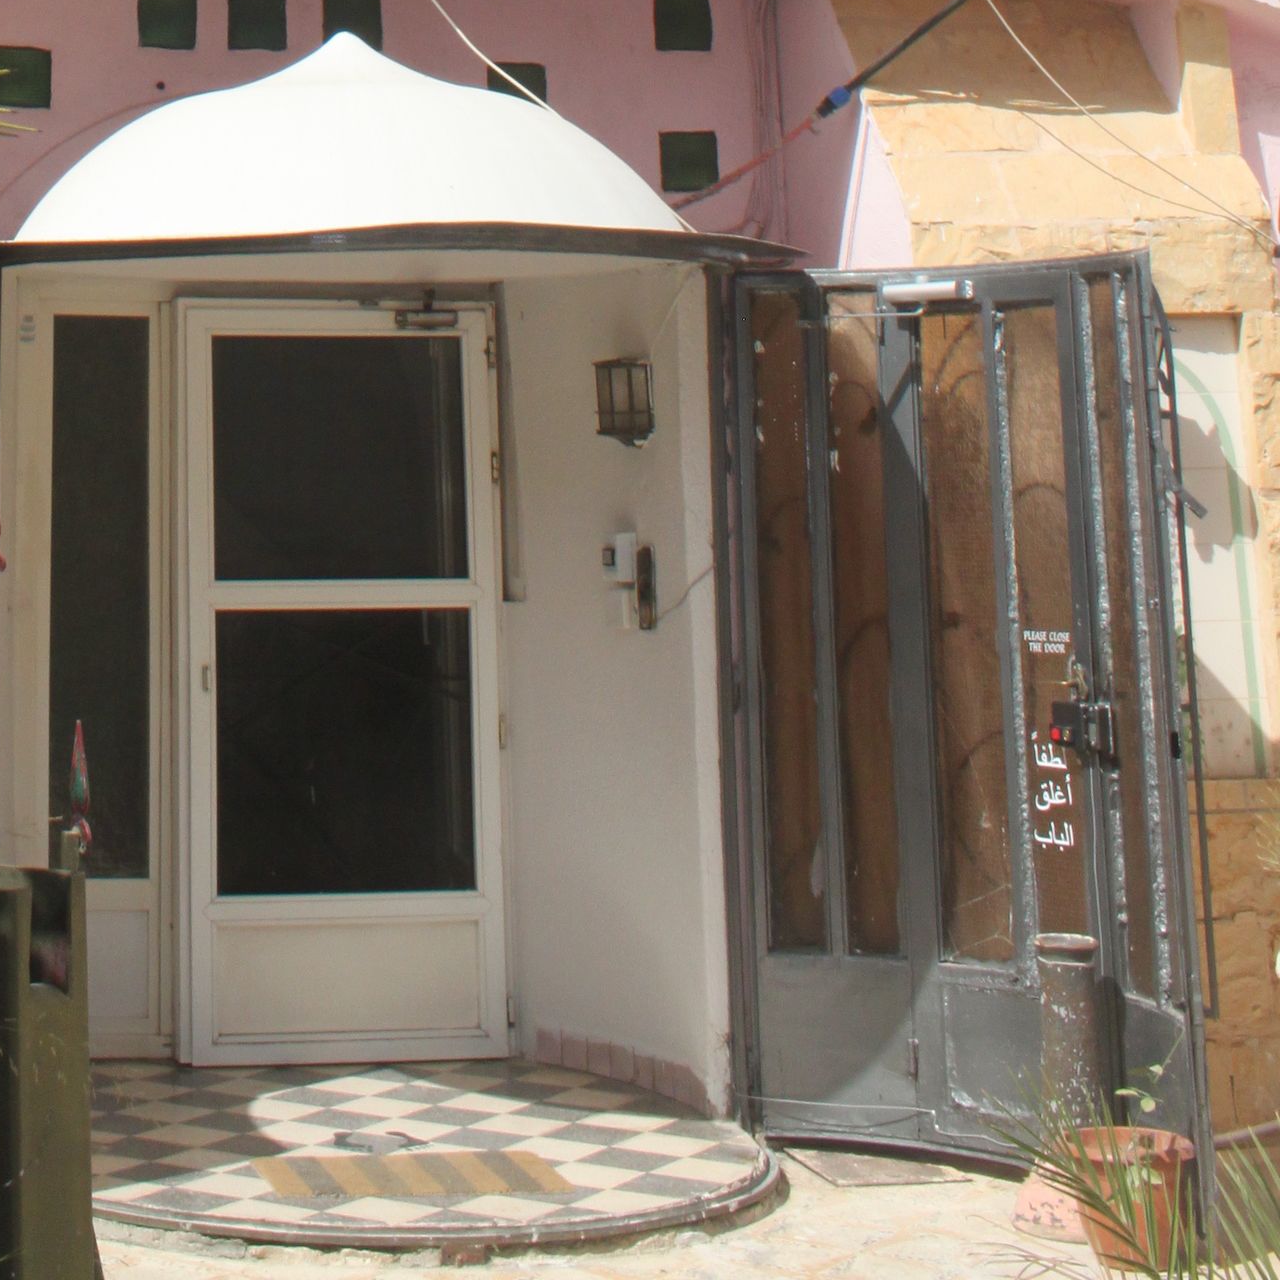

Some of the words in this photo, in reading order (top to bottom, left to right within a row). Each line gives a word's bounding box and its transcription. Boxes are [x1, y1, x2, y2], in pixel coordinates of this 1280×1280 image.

[1023, 630, 1047, 641] PLEASE
[1049, 631, 1070, 642] CLOSE
[1029, 642, 1041, 653] THE
[1044, 642, 1066, 654] DOOR
[1035, 773, 1072, 811] أغلق
[1033, 821, 1074, 852] الباب
